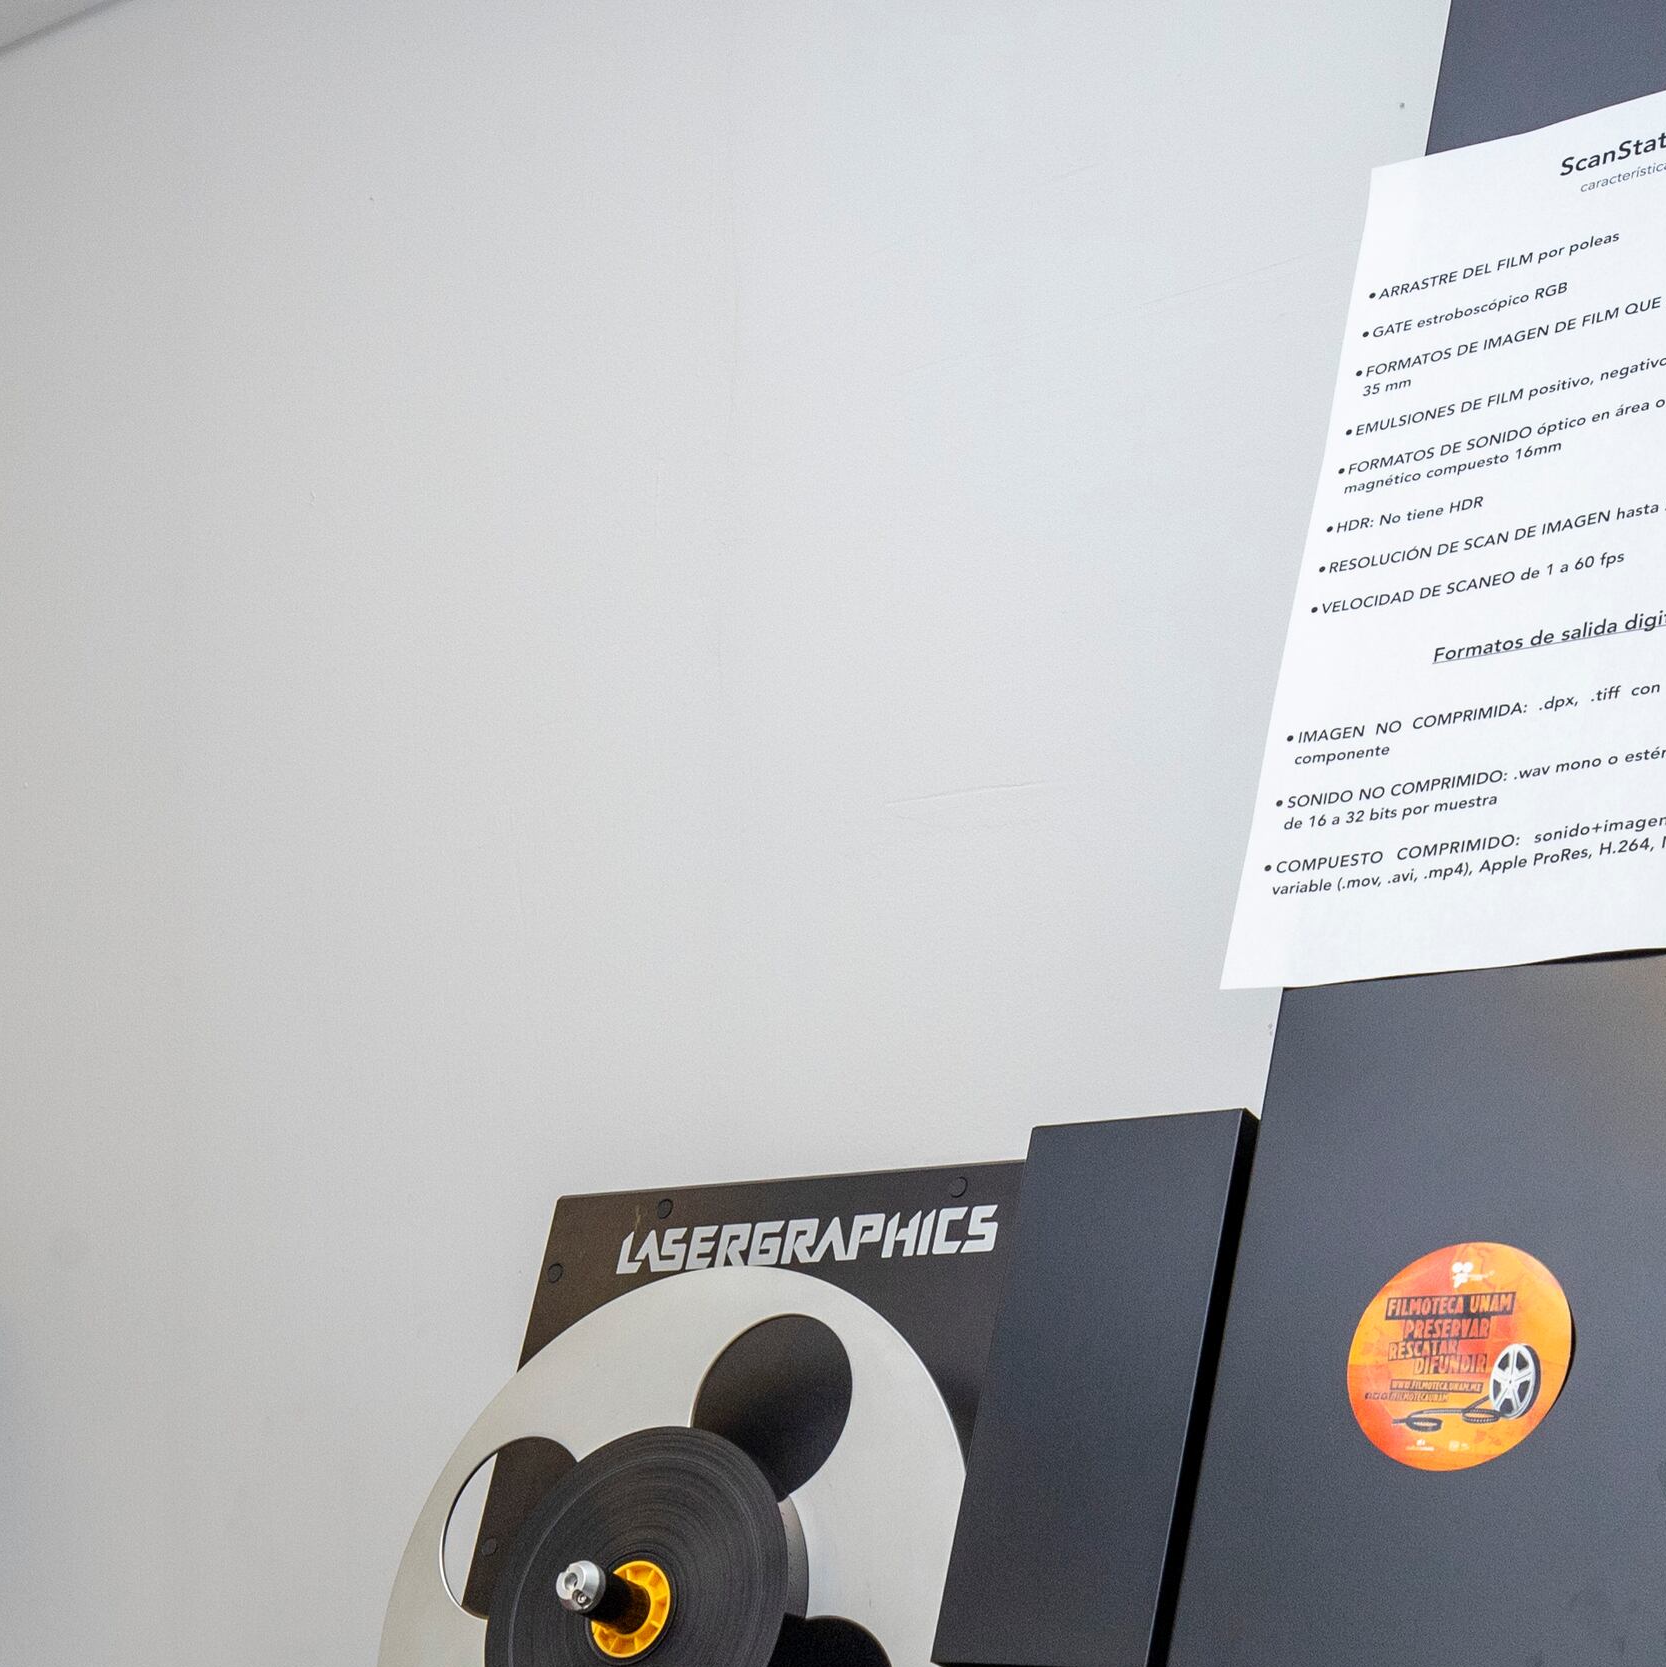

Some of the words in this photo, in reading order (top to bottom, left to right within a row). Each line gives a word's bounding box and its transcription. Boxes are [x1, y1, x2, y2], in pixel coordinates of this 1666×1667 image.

[1379, 271, 1458, 299] ARRASTRE
[1463, 264, 1491, 279] DEL
[1497, 252, 1533, 271] FILM
[1538, 247, 1565, 264] por
[1569, 233, 1619, 256] poleas
[1373, 320, 1412, 337] GATE
[1417, 295, 1529, 328] estroboscópico
[1535, 282, 1567, 300] RGB
[1365, 347, 1451, 377] FORMATOS
[1457, 341, 1478, 356] DE
[1484, 325, 1549, 350] IMAGEN
[1555, 318, 1576, 333] DE
[1582, 307, 1619, 327] FILM
[1625, 296, 1661, 315] QUE
[1356, 404, 1455, 436] EMULSIONES
[1461, 398, 1482, 413] DE
[1488, 388, 1524, 407] FILM
[1528, 377, 1593, 400] positivo,
[1363, 383, 1380, 396] 35
[1385, 379, 1411, 392] mm
[1348, 447, 1434, 475] FORMATOS
[1440, 441, 1461, 456] DE
[1466, 426, 1532, 450] SONIDO
[1537, 417, 1586, 437] óptico
[1592, 411, 1609, 422] en
[1616, 402, 1649, 416] área
[1344, 473, 1421, 494] magnético
[1427, 455, 1509, 478] compuesto
[1516, 443, 1561, 459] 16mm
[1329, 546, 1432, 573] RESOLUCIÓN
[1437, 541, 1459, 555] DE
[1464, 531, 1509, 550] SCAN
[1514, 525, 1536, 541] DE
[1542, 510, 1610, 535] IMAGEN
[1617, 504, 1659, 520] hasta
[1337, 517, 1374, 533] HDR:
[1379, 513, 1401, 526] No
[1407, 507, 1443, 521] tiene
[1449, 496, 1483, 513] HDR
[1322, 590, 1414, 614] VELOCIDAD
[1420, 585, 1441, 599] DE
[1446, 571, 1515, 594] SCANEO
[1521, 567, 1539, 580] de
[1547, 564, 1553, 575] 1
[1575, 556, 1594, 570] 60
[1600, 552, 1624, 568] fps
[1433, 637, 1523, 663] Formatos
[1530, 630, 1554, 646] de
[1561, 618, 1618, 640] salida
[1298, 725, 1365, 743] IMAGEN
[1376, 720, 1401, 735] NO
[1413, 702, 1527, 729] COMPRIMIDA:
[1539, 696, 1578, 712] .dpx,
[1591, 685, 1621, 702] .tiff
[1631, 684, 1660, 696] con
[1295, 746, 1390, 765] componente
[1287, 790, 1353, 808] SONIDO
[1359, 786, 1385, 800] NO
[1391, 770, 1507, 796] COMPRIMIDO:
[1514, 766, 1550, 780] .wav
[1556, 758, 1601, 773] mono
[1284, 817, 1302, 830] de
[1310, 814, 1326, 827] 16
[1346, 810, 1364, 823] 32
[1369, 808, 1397, 821] bits
[1402, 805, 1429, 820] por
[1434, 796, 1497, 812] muestra
[1273, 879, 1332, 895] variable
[1337, 876, 1381, 891] (.mov,
[1388, 868, 1417, 884] .avi,
[1424, 862, 1472, 880] .mp4),
[1479, 855, 1527, 875] Apple
[1533, 848, 1592, 866] ProRes,
[1599, 837, 1654, 855] H.264,
[1277, 851, 1383, 873] COMPUESTO
[1397, 834, 1520, 860] COMPRIMIDO:
[616, 1204, 999, 1274] LASERGRAPHICS
[1387, 1296, 1464, 1316] FILMOTECA
[1470, 1293, 1512, 1313] UNAM
[1404, 1318, 1490, 1338] PRESERVAR
[1414, 1355, 1486, 1374] DIFUNDIR
